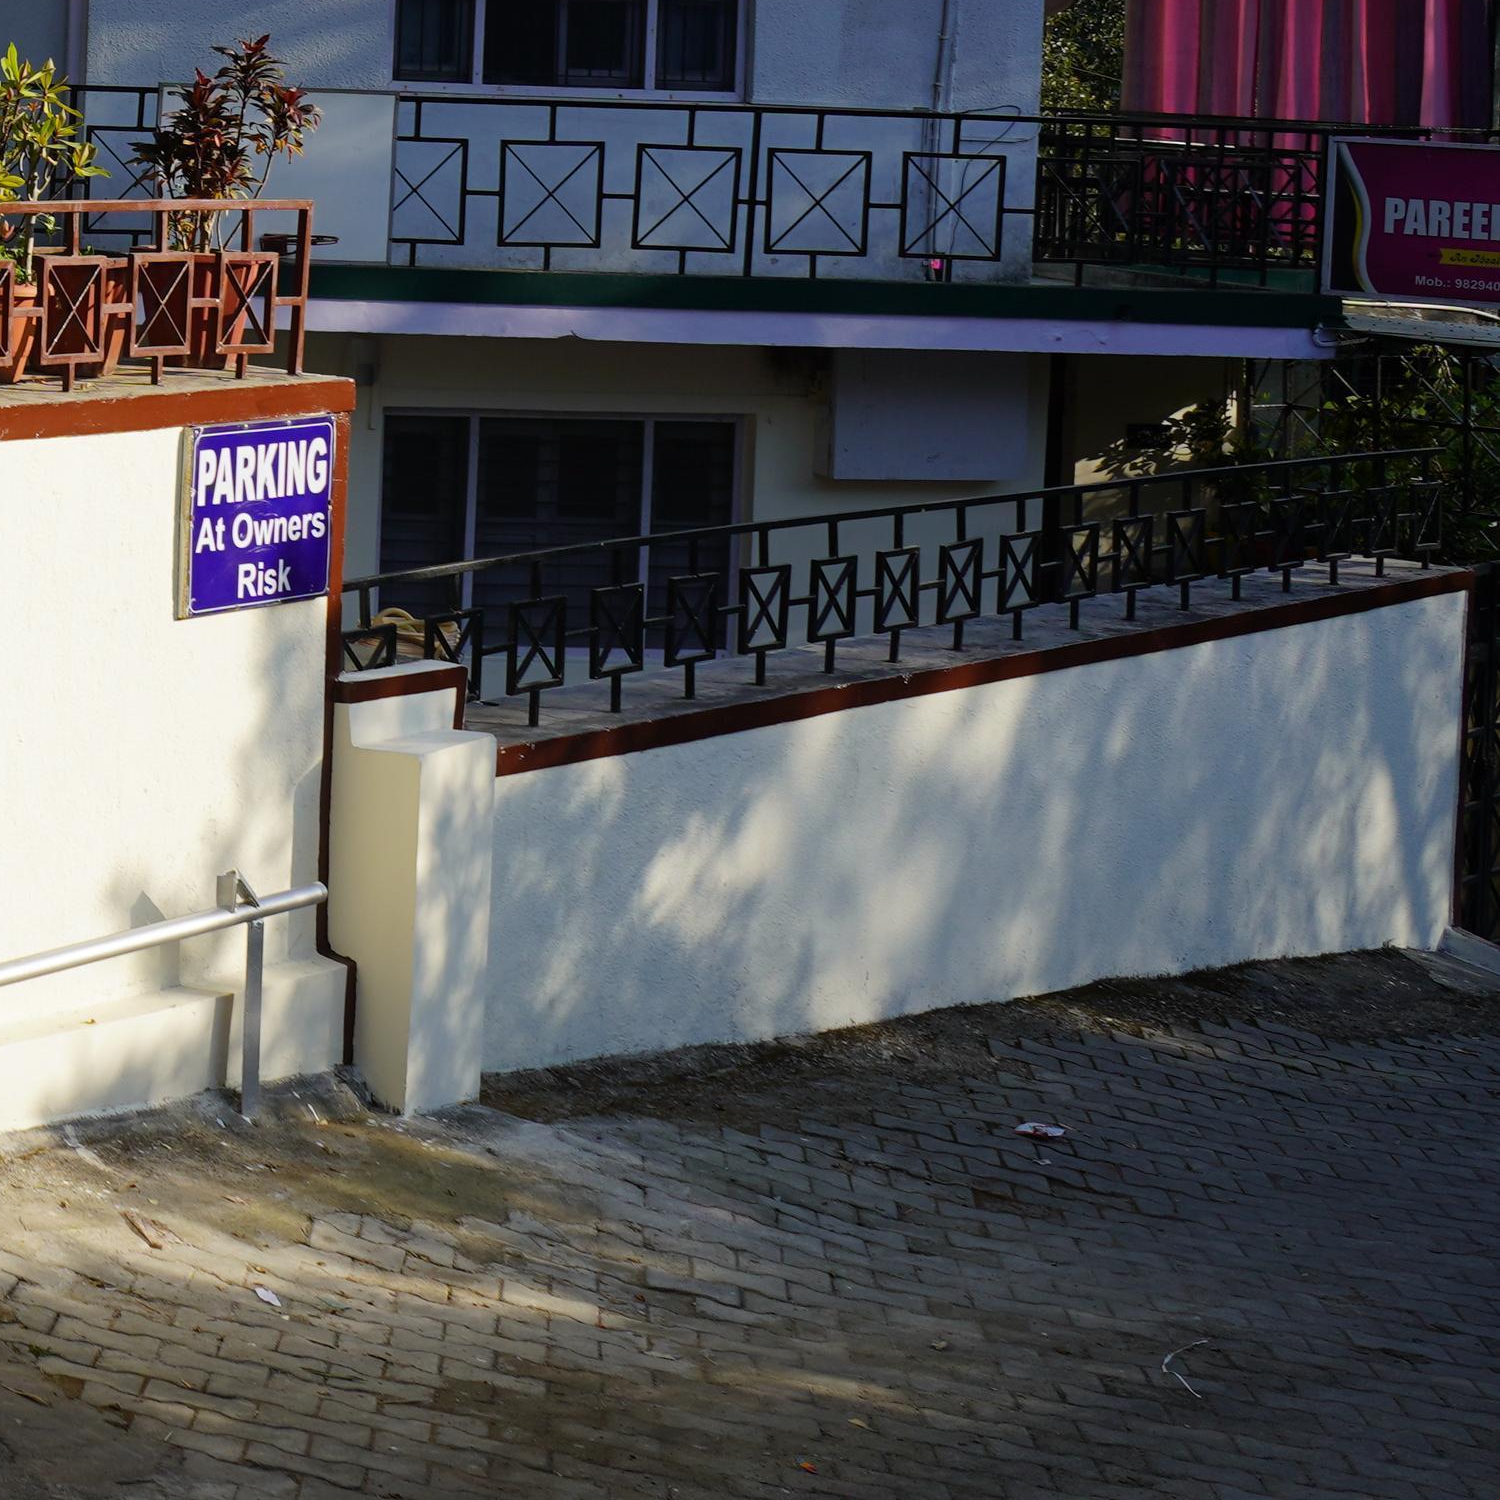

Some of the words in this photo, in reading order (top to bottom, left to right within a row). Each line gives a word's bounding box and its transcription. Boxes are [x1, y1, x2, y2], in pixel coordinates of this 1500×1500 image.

[1415, 276, 1451, 288] Mob.:
[196, 437, 328, 507] PARKING
[195, 517, 225, 553] At
[232, 511, 326, 549] Owners
[237, 559, 291, 599] Risk
